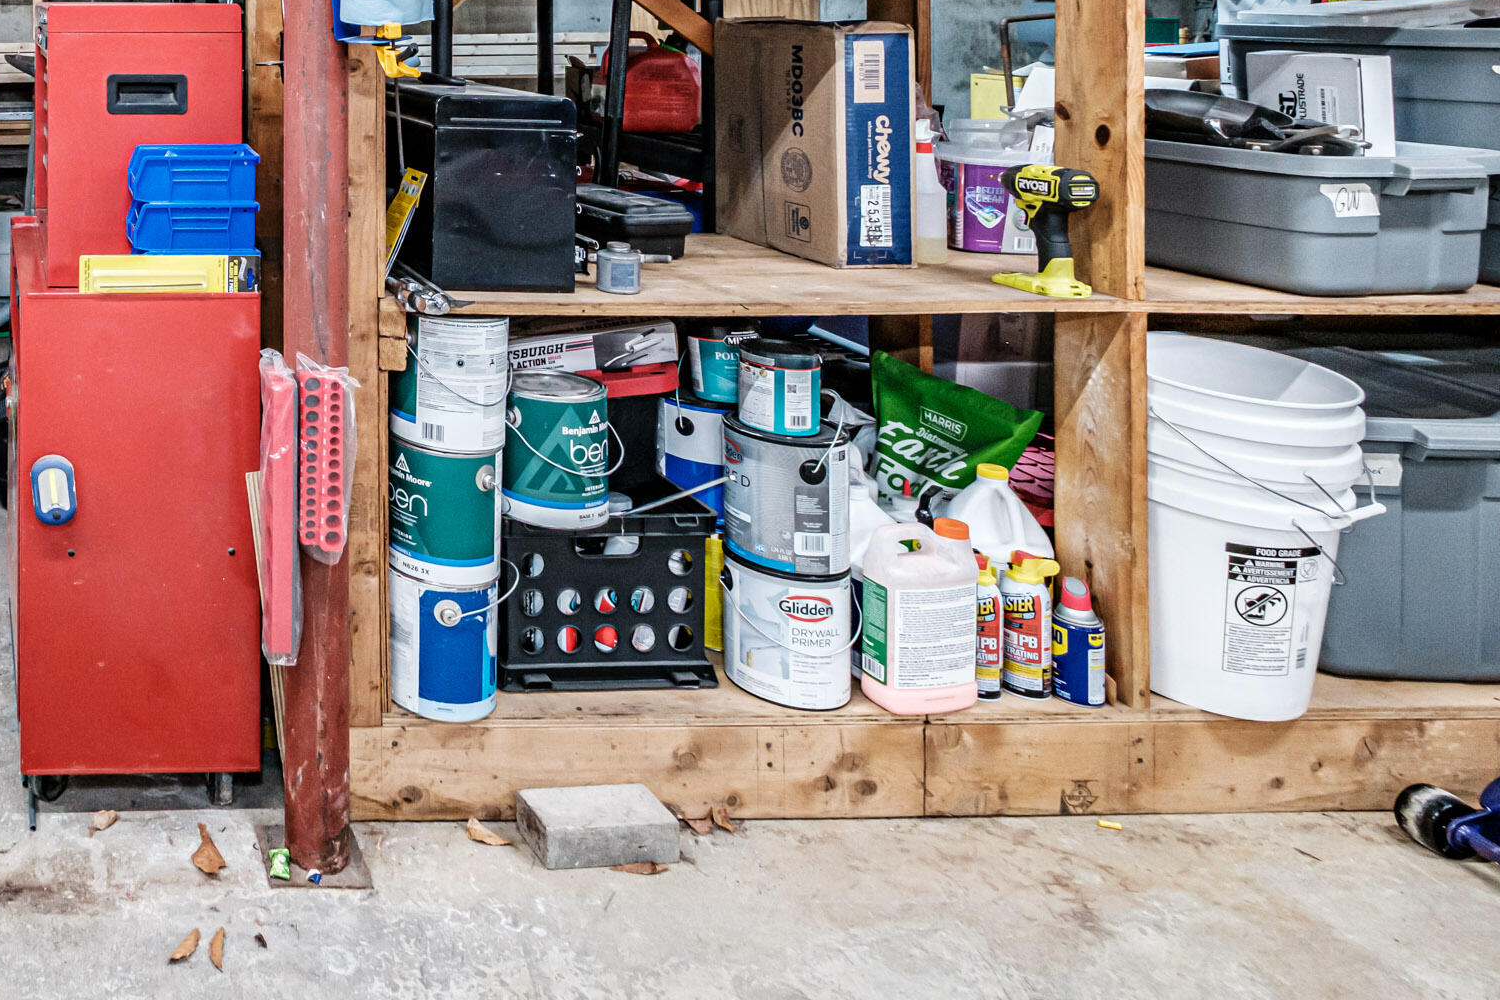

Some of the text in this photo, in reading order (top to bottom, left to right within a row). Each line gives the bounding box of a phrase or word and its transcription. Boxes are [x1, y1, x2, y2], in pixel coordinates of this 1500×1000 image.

[873, 114, 893, 185] chewy
[1018, 178, 1049, 192] RYOBI
[508, 342, 565, 361] TSBURGH
[516, 357, 547, 369] ACTION
[924, 410, 962, 435] HARRIS
[561, 425, 598, 437] Benjamin
[569, 439, 609, 465] ben
[877, 420, 969, 480] Earth
[405, 472, 430, 488] Moore
[1255, 547, 1301, 558] FOOD GRADE
[779, 599, 833, 616] Glidden
[1004, 596, 1035, 613] STER
[791, 627, 841, 638] DRYWALL
[791, 637, 831, 648] PRIMER
[977, 652, 998, 661] ATING
[1006, 645, 1039, 661] TRATING
